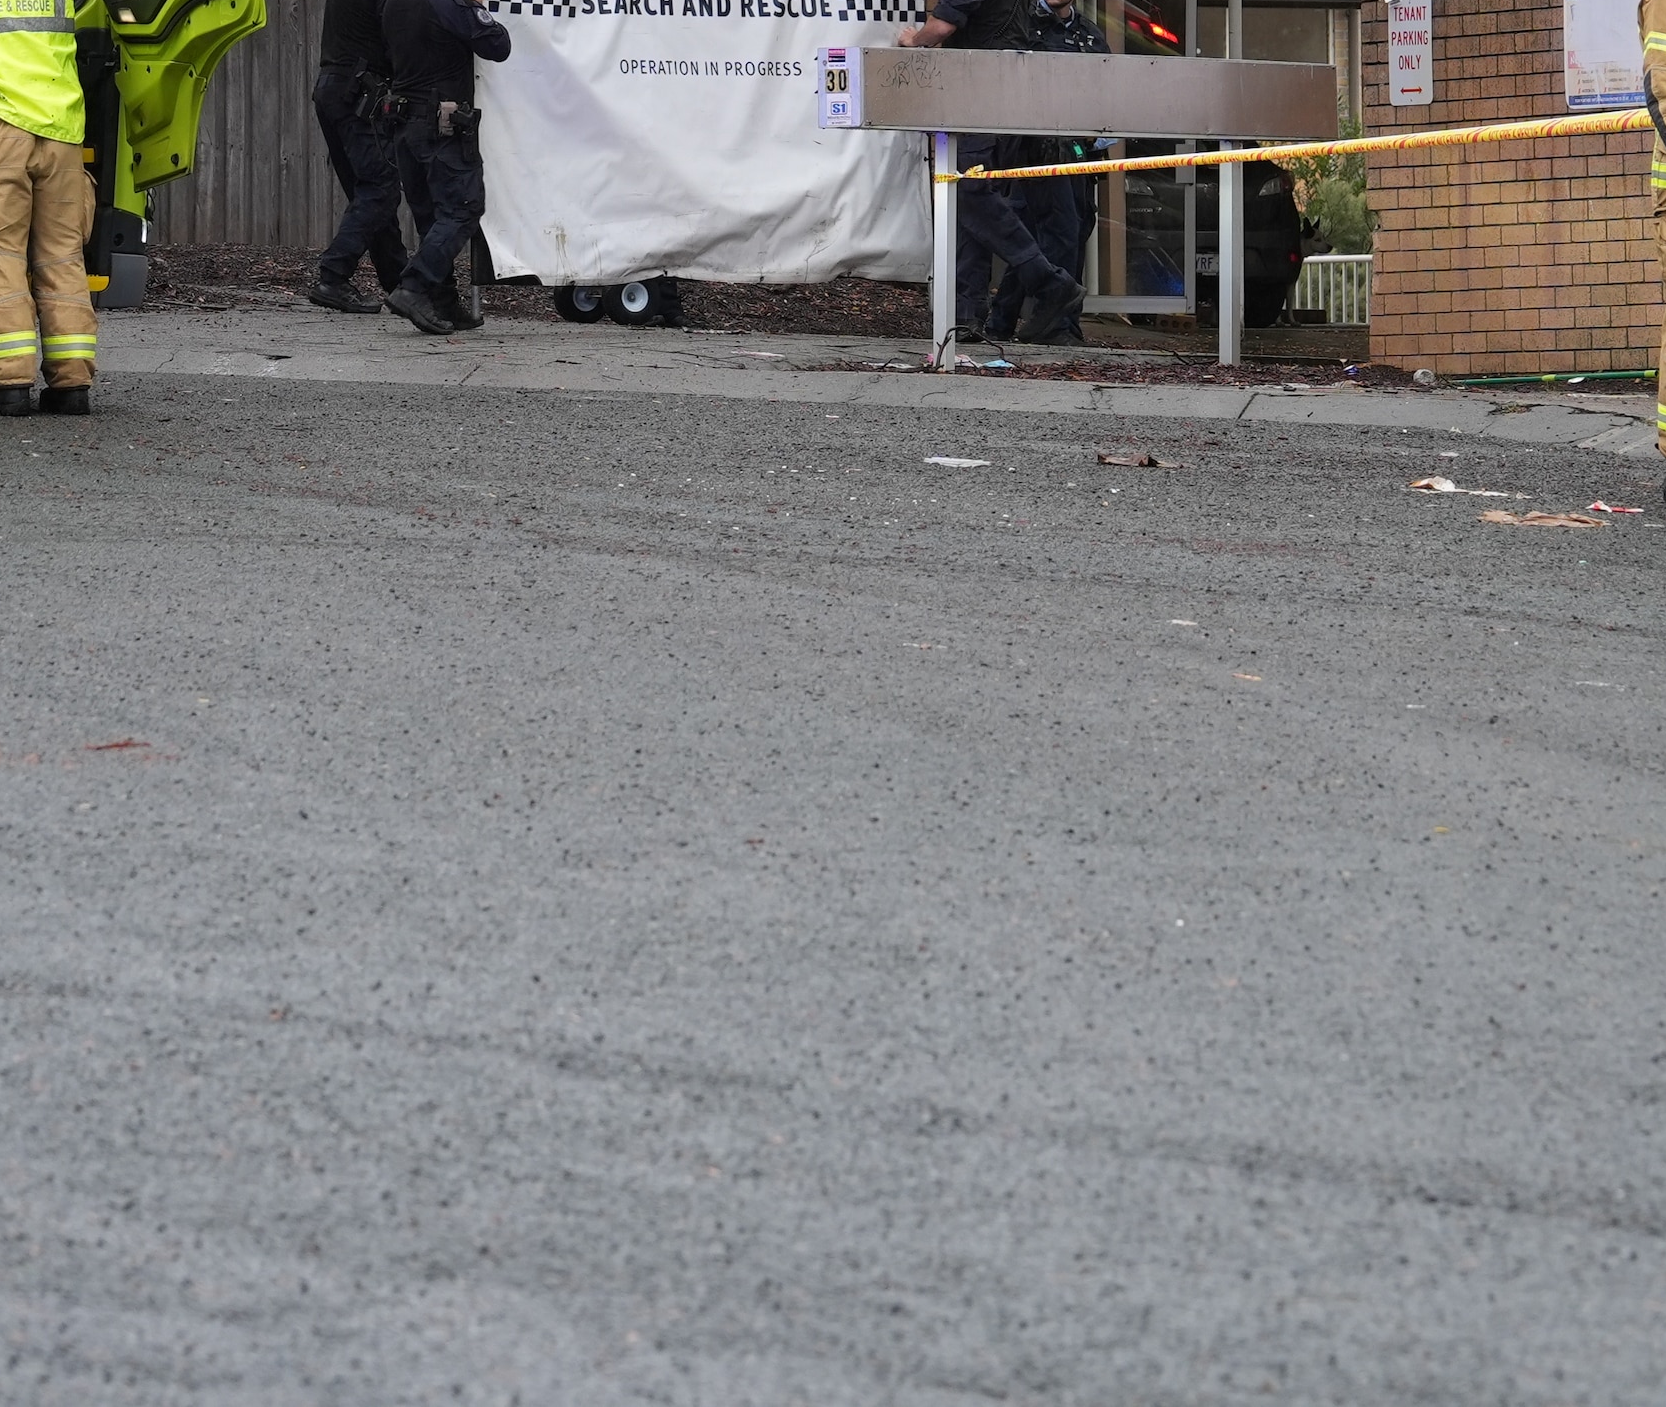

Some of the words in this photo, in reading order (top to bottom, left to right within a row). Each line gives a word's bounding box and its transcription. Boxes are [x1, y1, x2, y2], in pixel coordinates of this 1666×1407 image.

[6, 1, 12, 13] &
[16, 0, 51, 13] RESCUE
[1394, 5, 1427, 22] TENANT
[1391, 31, 1429, 47] PARKING
[620, 59, 699, 76] OPERATION
[705, 60, 719, 76] IN
[725, 61, 803, 77] PROGRESS
[1398, 54, 1421, 70] ONLY
[827, 69, 847, 92] 30
[832, 103, 846, 114] S1
